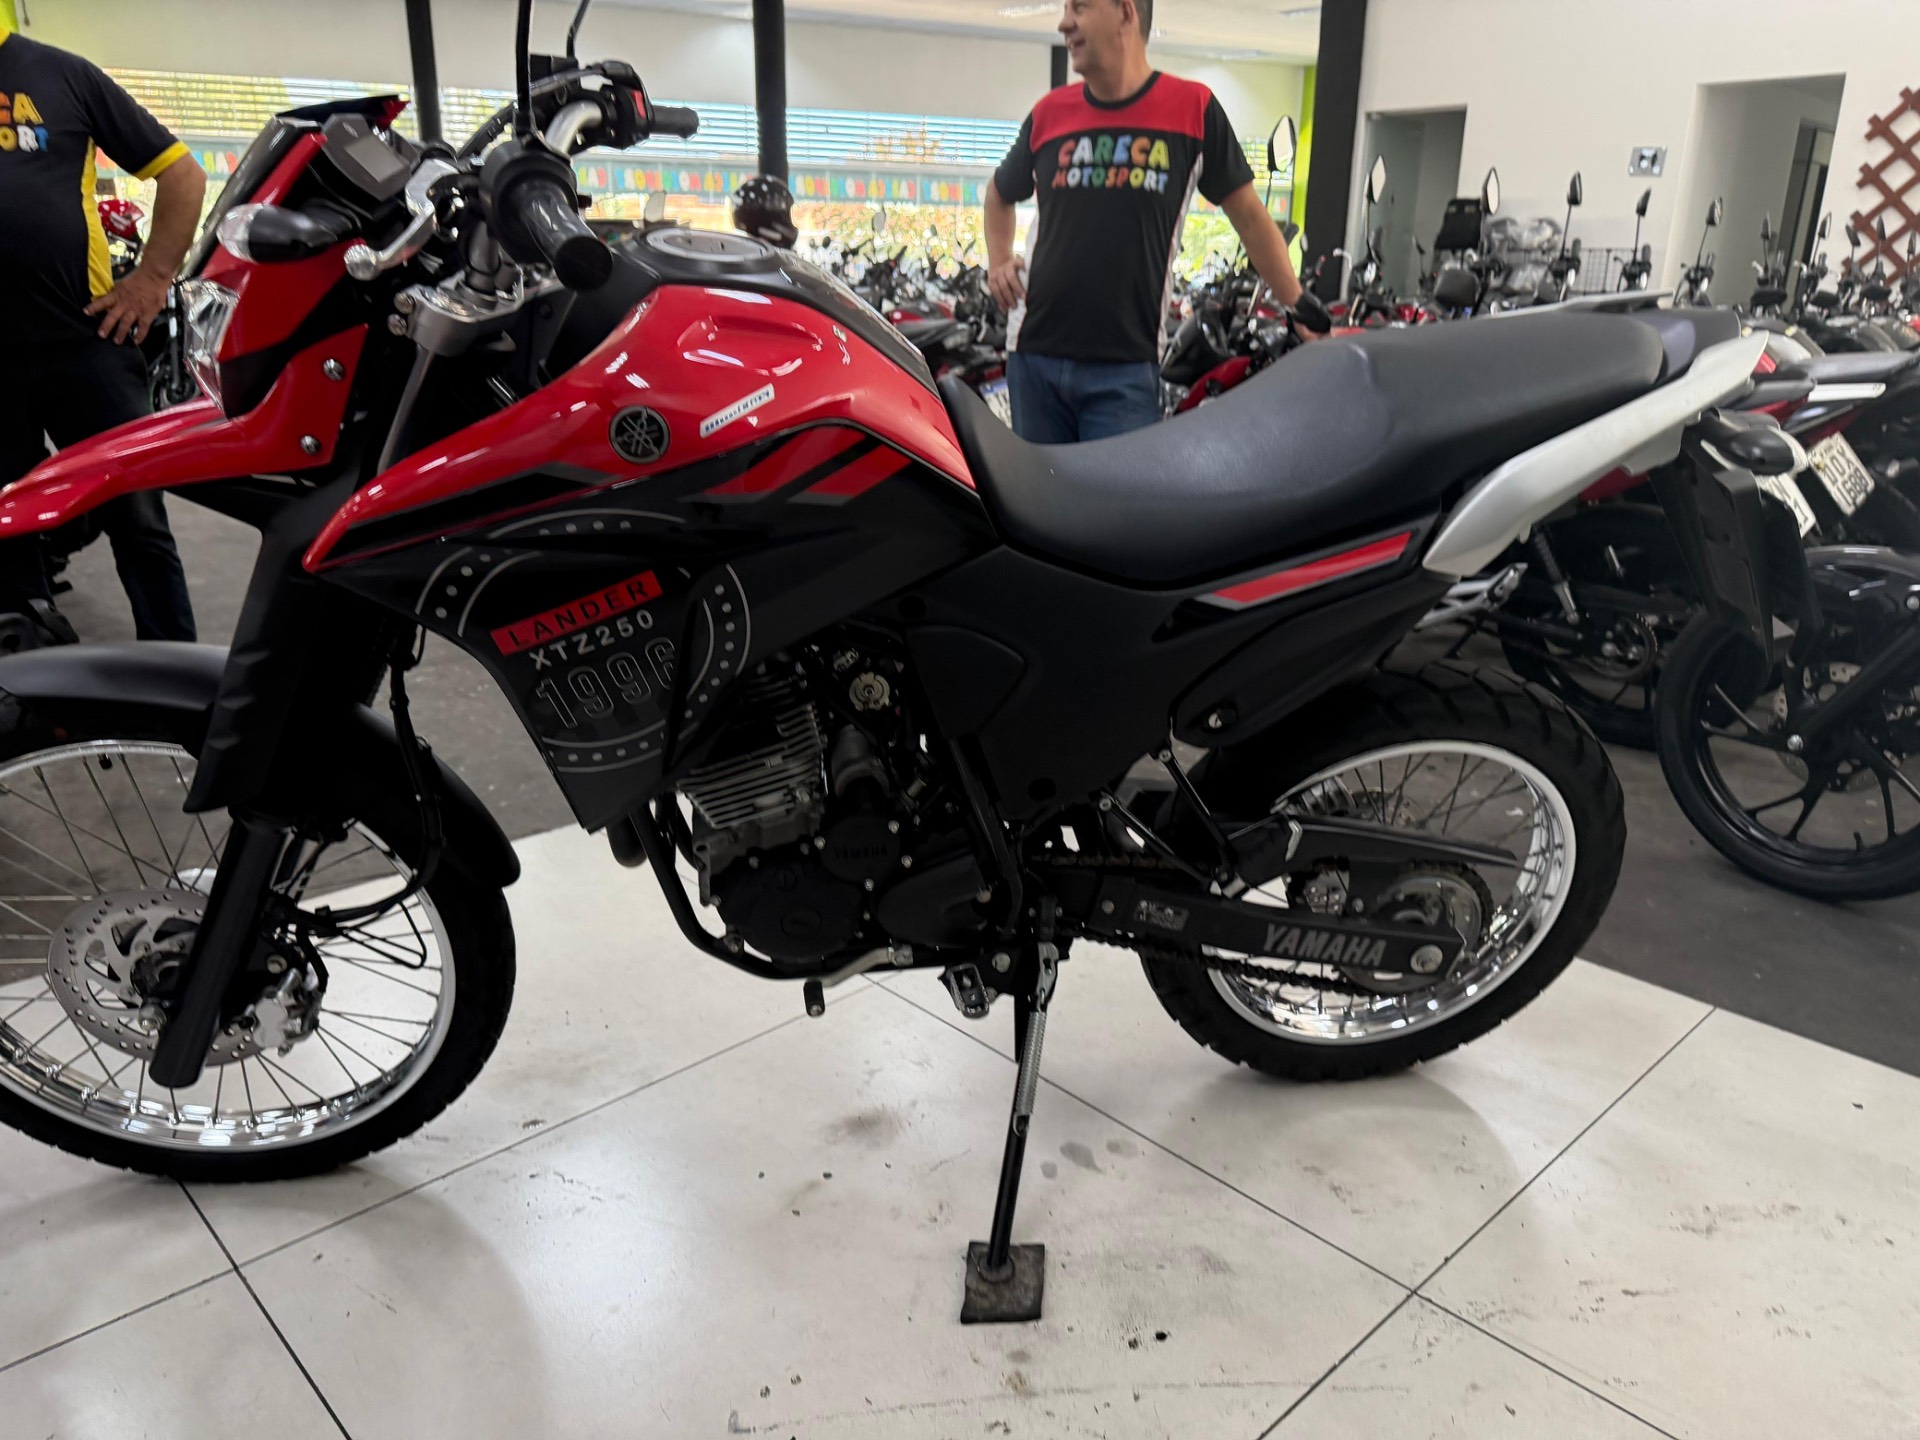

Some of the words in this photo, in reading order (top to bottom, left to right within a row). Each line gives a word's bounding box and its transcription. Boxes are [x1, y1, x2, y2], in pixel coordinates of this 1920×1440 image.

[1057, 134, 1170, 170] CARECA
[1051, 166, 1168, 194] MOTOSPORT
[507, 581, 649, 647] LANDER
[528, 609, 654, 671] XTZ250
[535, 637, 676, 729] 1996
[1263, 923, 1387, 967] YAMAHA
